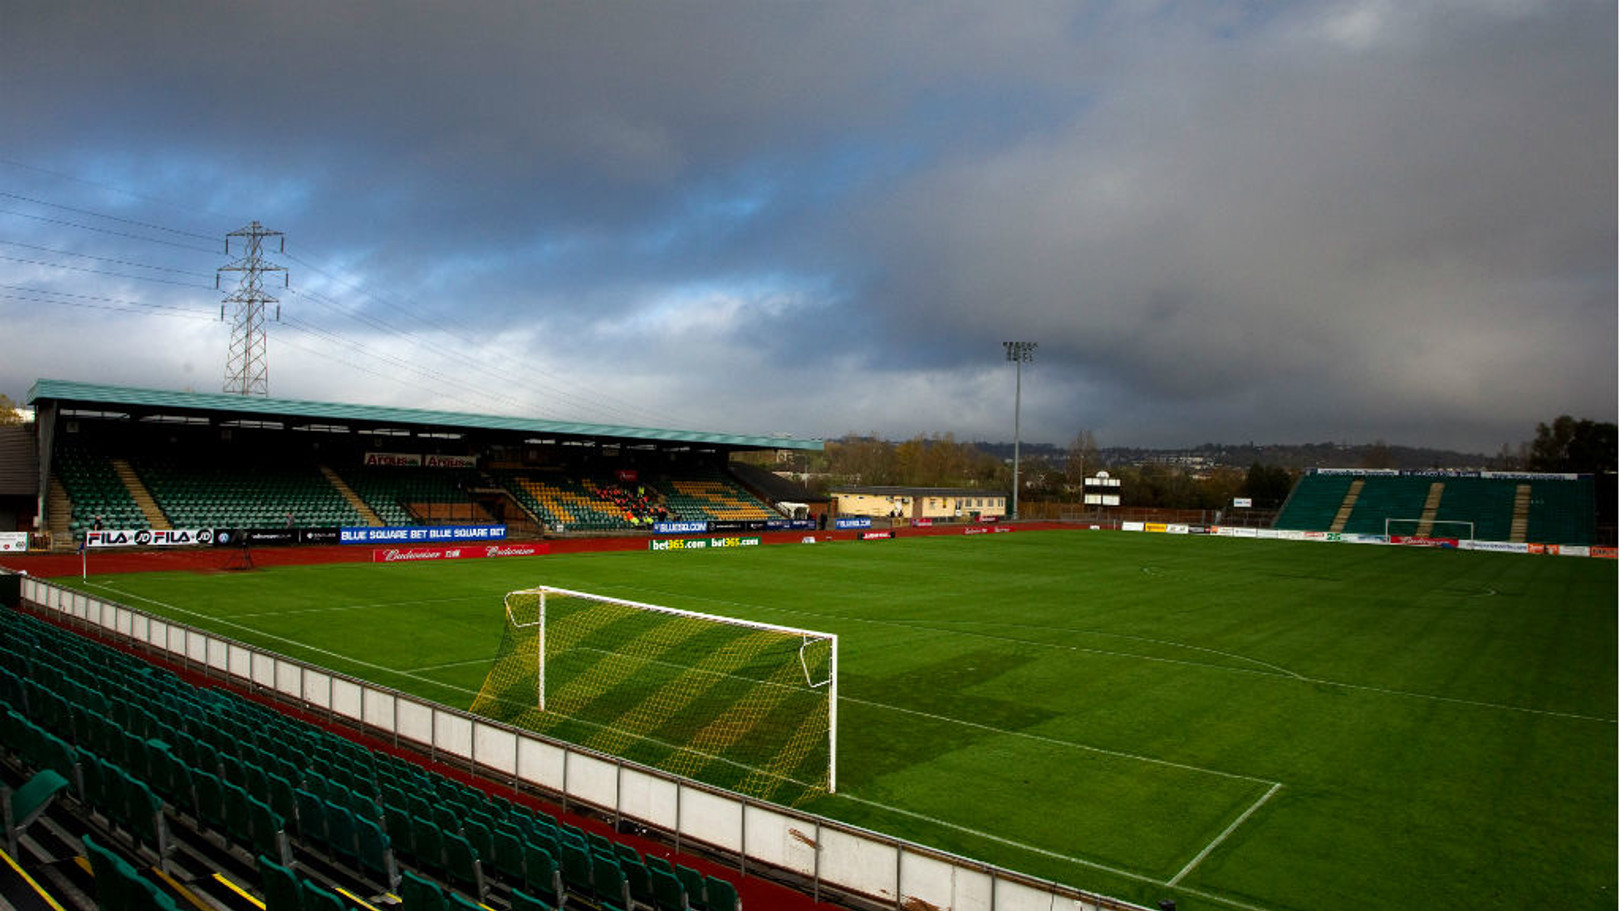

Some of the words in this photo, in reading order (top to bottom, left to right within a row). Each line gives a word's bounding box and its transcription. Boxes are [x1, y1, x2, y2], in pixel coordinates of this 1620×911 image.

[88, 532, 128, 545] FILA
[136, 532, 150, 543] JD
[154, 531, 190, 543] FILA
[197, 530, 211, 541] JD
[341, 530, 366, 541] BLUE
[369, 529, 408, 540] SQUARE
[410, 529, 428, 539] BET
[429, 528, 451, 539] BLUE
[454, 528, 488, 538] SQUARE
[490, 527, 506, 537] BET
[653, 539, 706, 550] bet365.com
[711, 536, 759, 547] bet365.com
[383, 549, 440, 561] Budweiser
[485, 545, 535, 557] Budweiser
